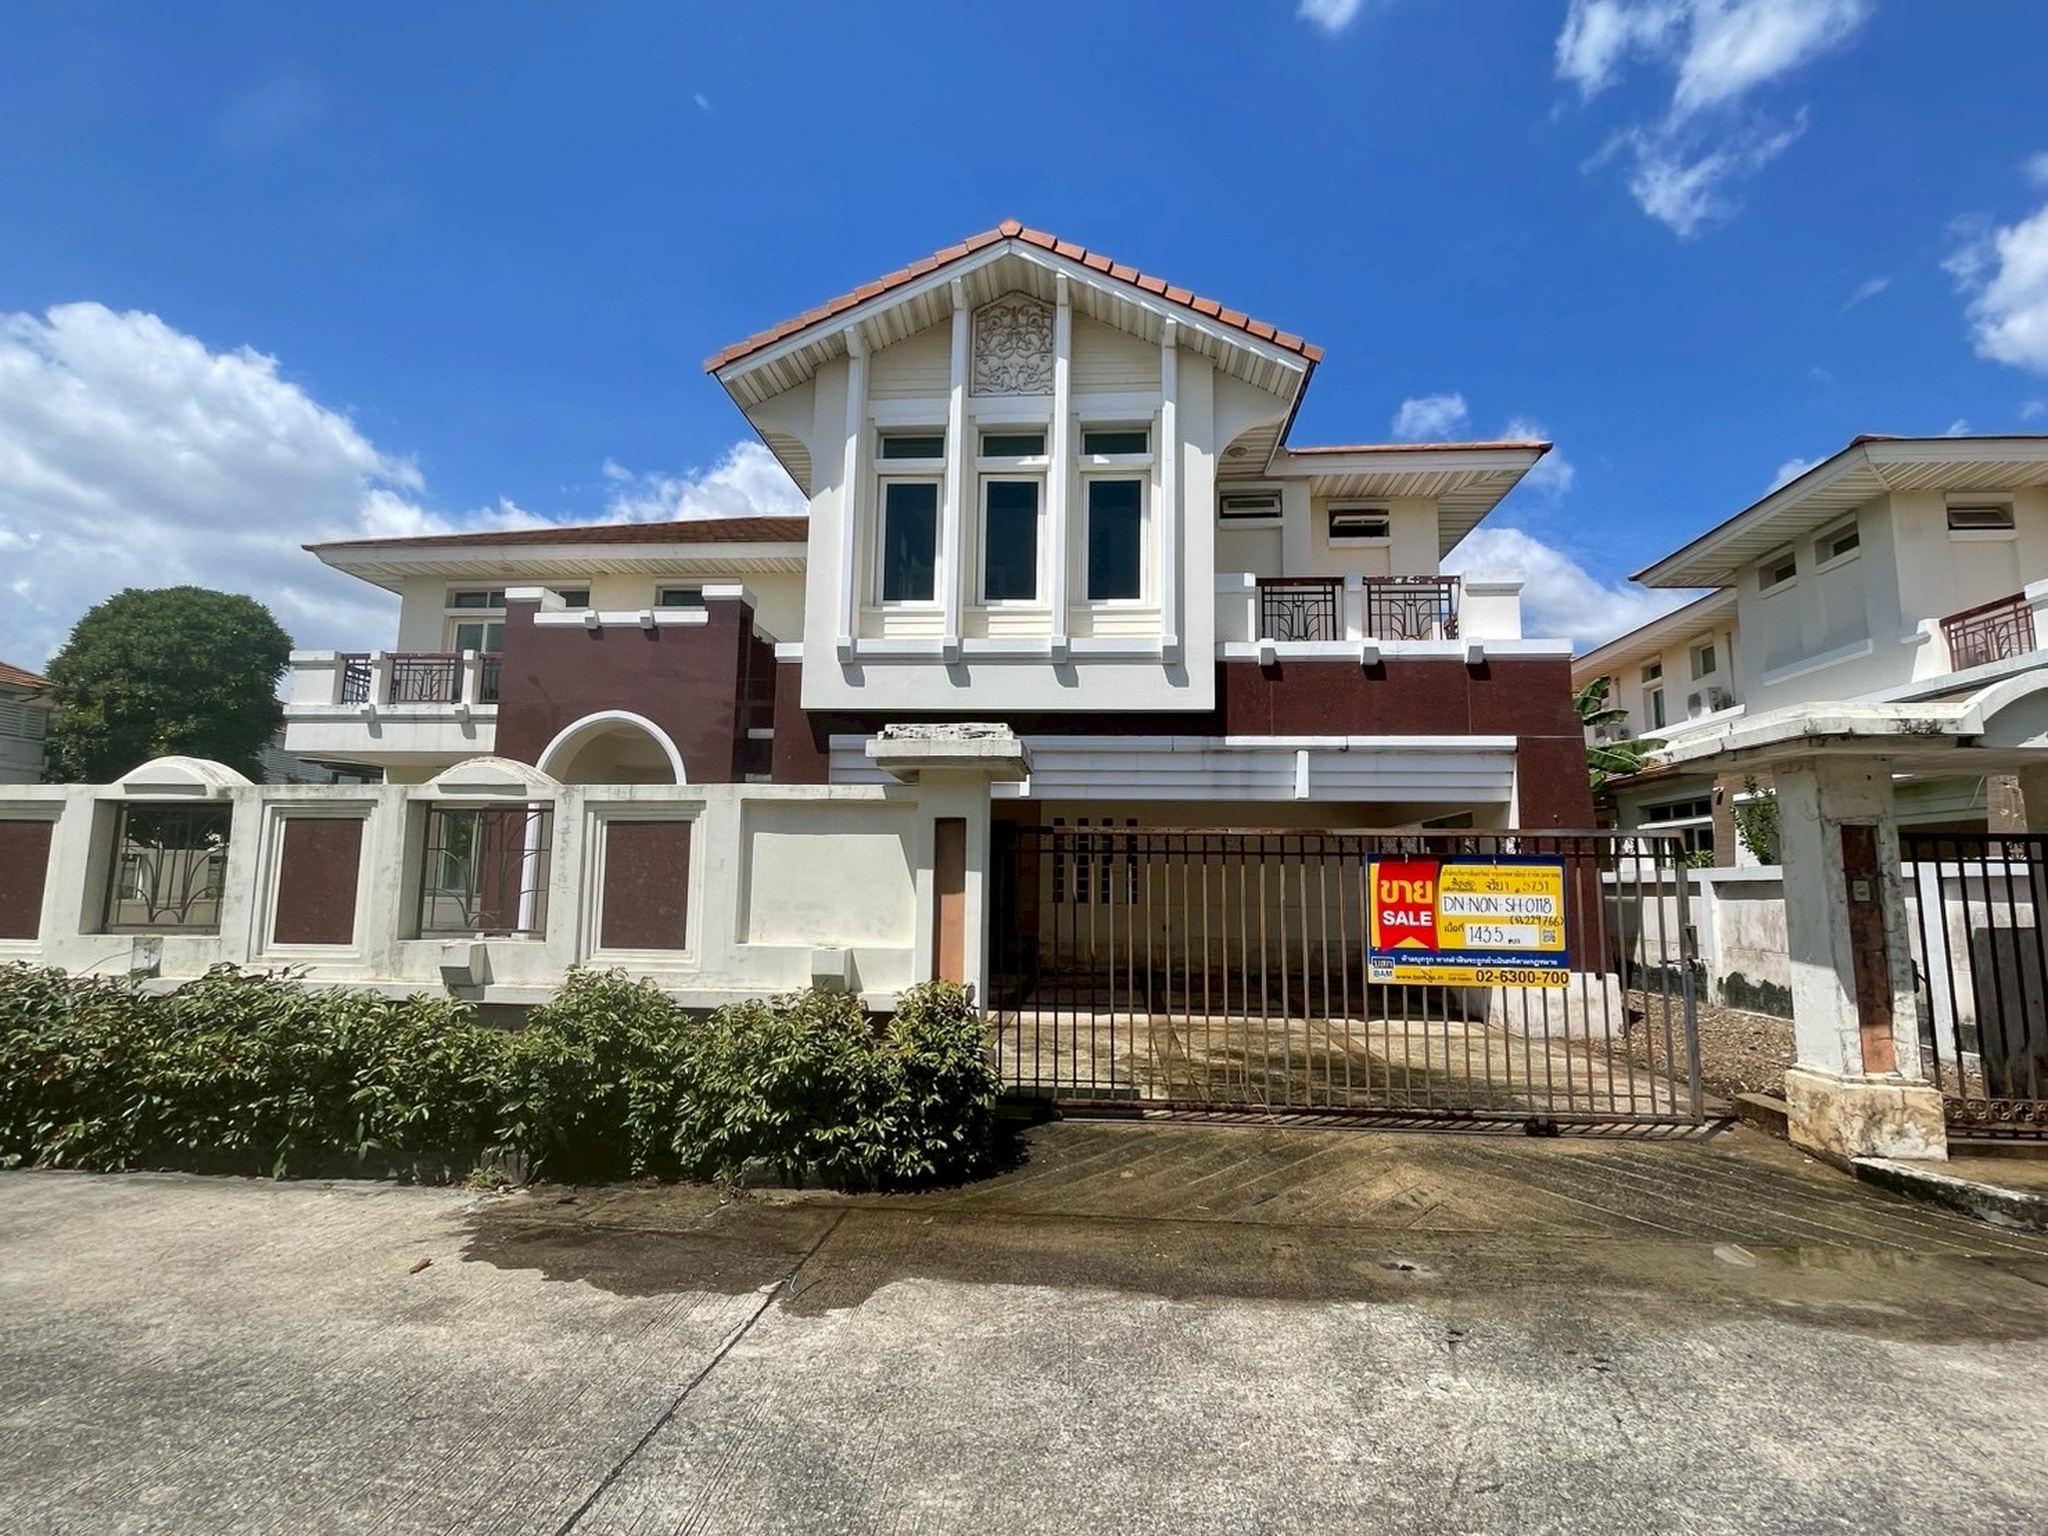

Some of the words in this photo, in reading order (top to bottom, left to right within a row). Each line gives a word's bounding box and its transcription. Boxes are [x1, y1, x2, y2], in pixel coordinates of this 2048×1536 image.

[1380, 879, 1433, 904] ขาย
[1383, 910, 1433, 926] SALE
[1373, 969, 1393, 977] BAM
[1475, 969, 1569, 984] 02-6300-700
